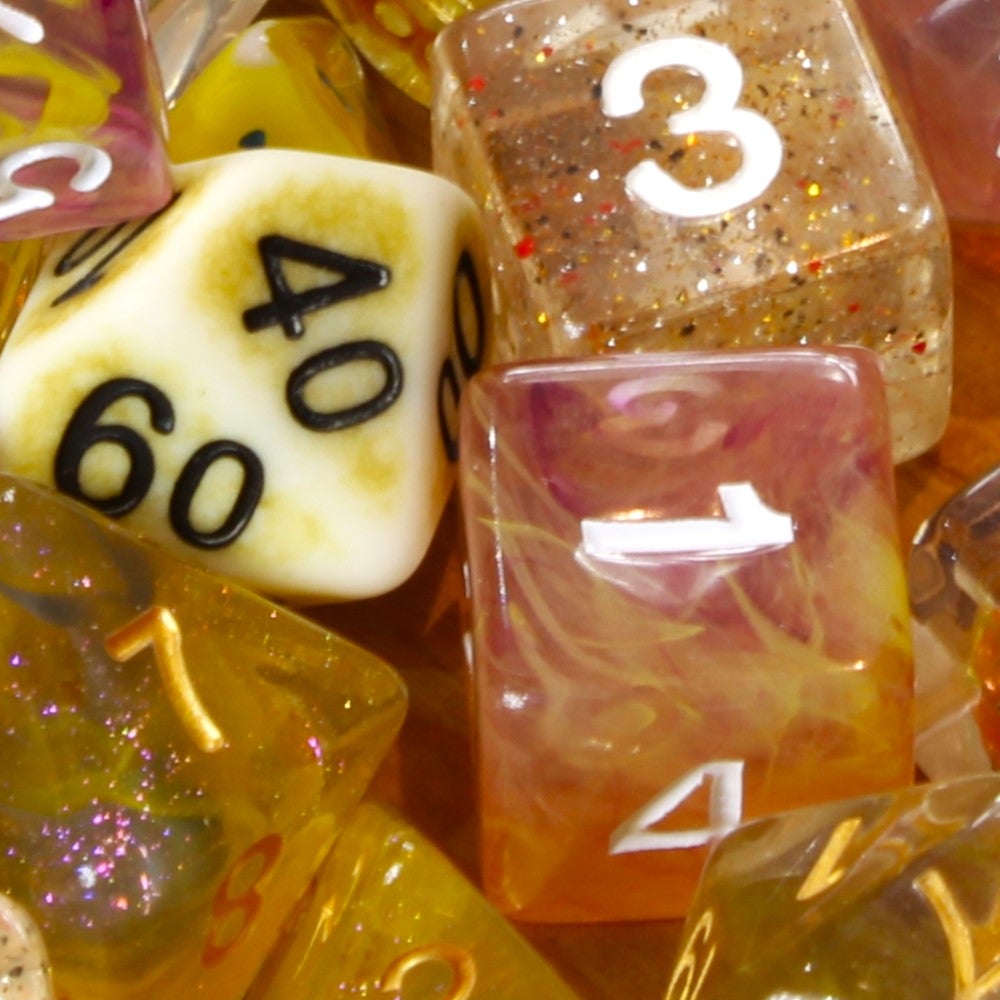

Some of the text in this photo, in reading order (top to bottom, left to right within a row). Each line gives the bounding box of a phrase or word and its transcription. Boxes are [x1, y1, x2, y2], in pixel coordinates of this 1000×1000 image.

[601, 36, 783, 218] 3
[241, 233, 404, 431] 40
[54, 376, 265, 550] 60
[576, 482, 796, 568] 1
[104, 605, 226, 753] 7
